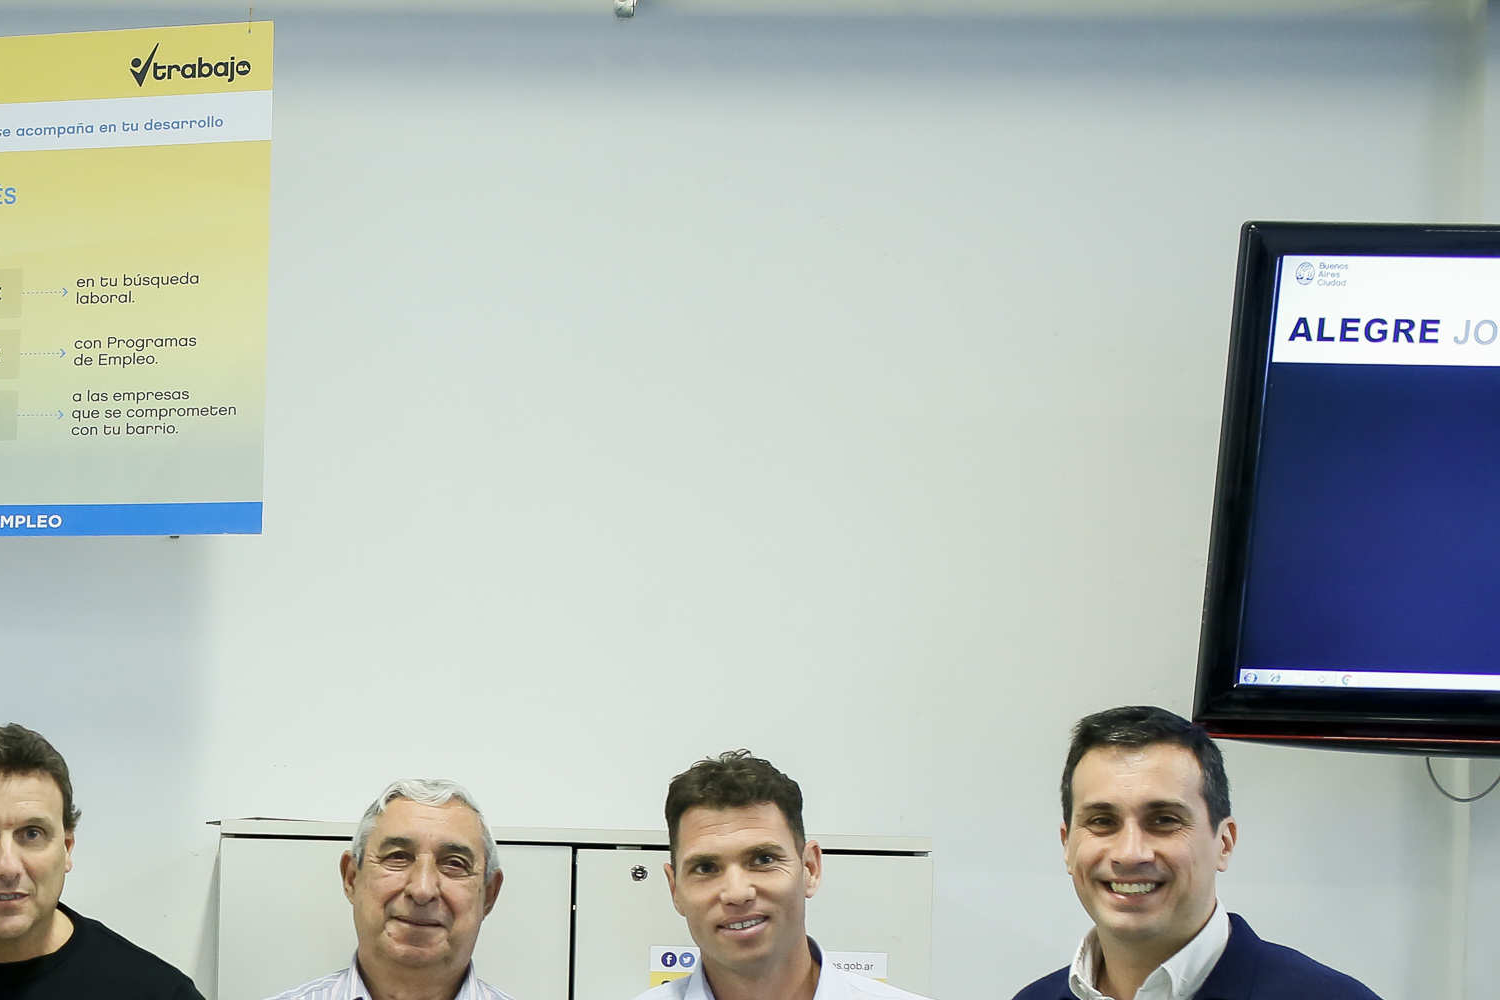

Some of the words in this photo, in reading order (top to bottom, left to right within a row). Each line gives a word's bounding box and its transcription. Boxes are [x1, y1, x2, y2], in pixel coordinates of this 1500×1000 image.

[153, 56, 251, 83] trabajo
[16, 122, 94, 140] acompaña
[99, 123, 117, 132] en
[122, 121, 139, 132] tu
[144, 116, 224, 132] desarrollo
[1319, 262, 1349, 270] Buenos
[76, 276, 95, 288] en
[100, 275, 118, 287] tu
[123, 272, 200, 289] búsqueda
[1317, 279, 1347, 287] Ciudad
[75, 290, 135, 305] laboral.
[1288, 316, 1441, 344] ALEGRE
[1453, 319, 1499, 345] JO
[74, 339, 102, 350] con
[107, 335, 197, 351] Programas
[73, 353, 93, 366] de
[98, 353, 158, 369] Empleo.
[72, 392, 82, 402] a
[87, 389, 109, 402] las
[113, 388, 190, 404] empresas
[71, 409, 99, 422] que
[105, 408, 123, 419] se
[126, 404, 237, 422] comprometen
[71, 425, 98, 437] con
[103, 424, 121, 435] tu
[126, 422, 179, 435] barrio.
[832, 962, 874, 972] s.gob.ar
